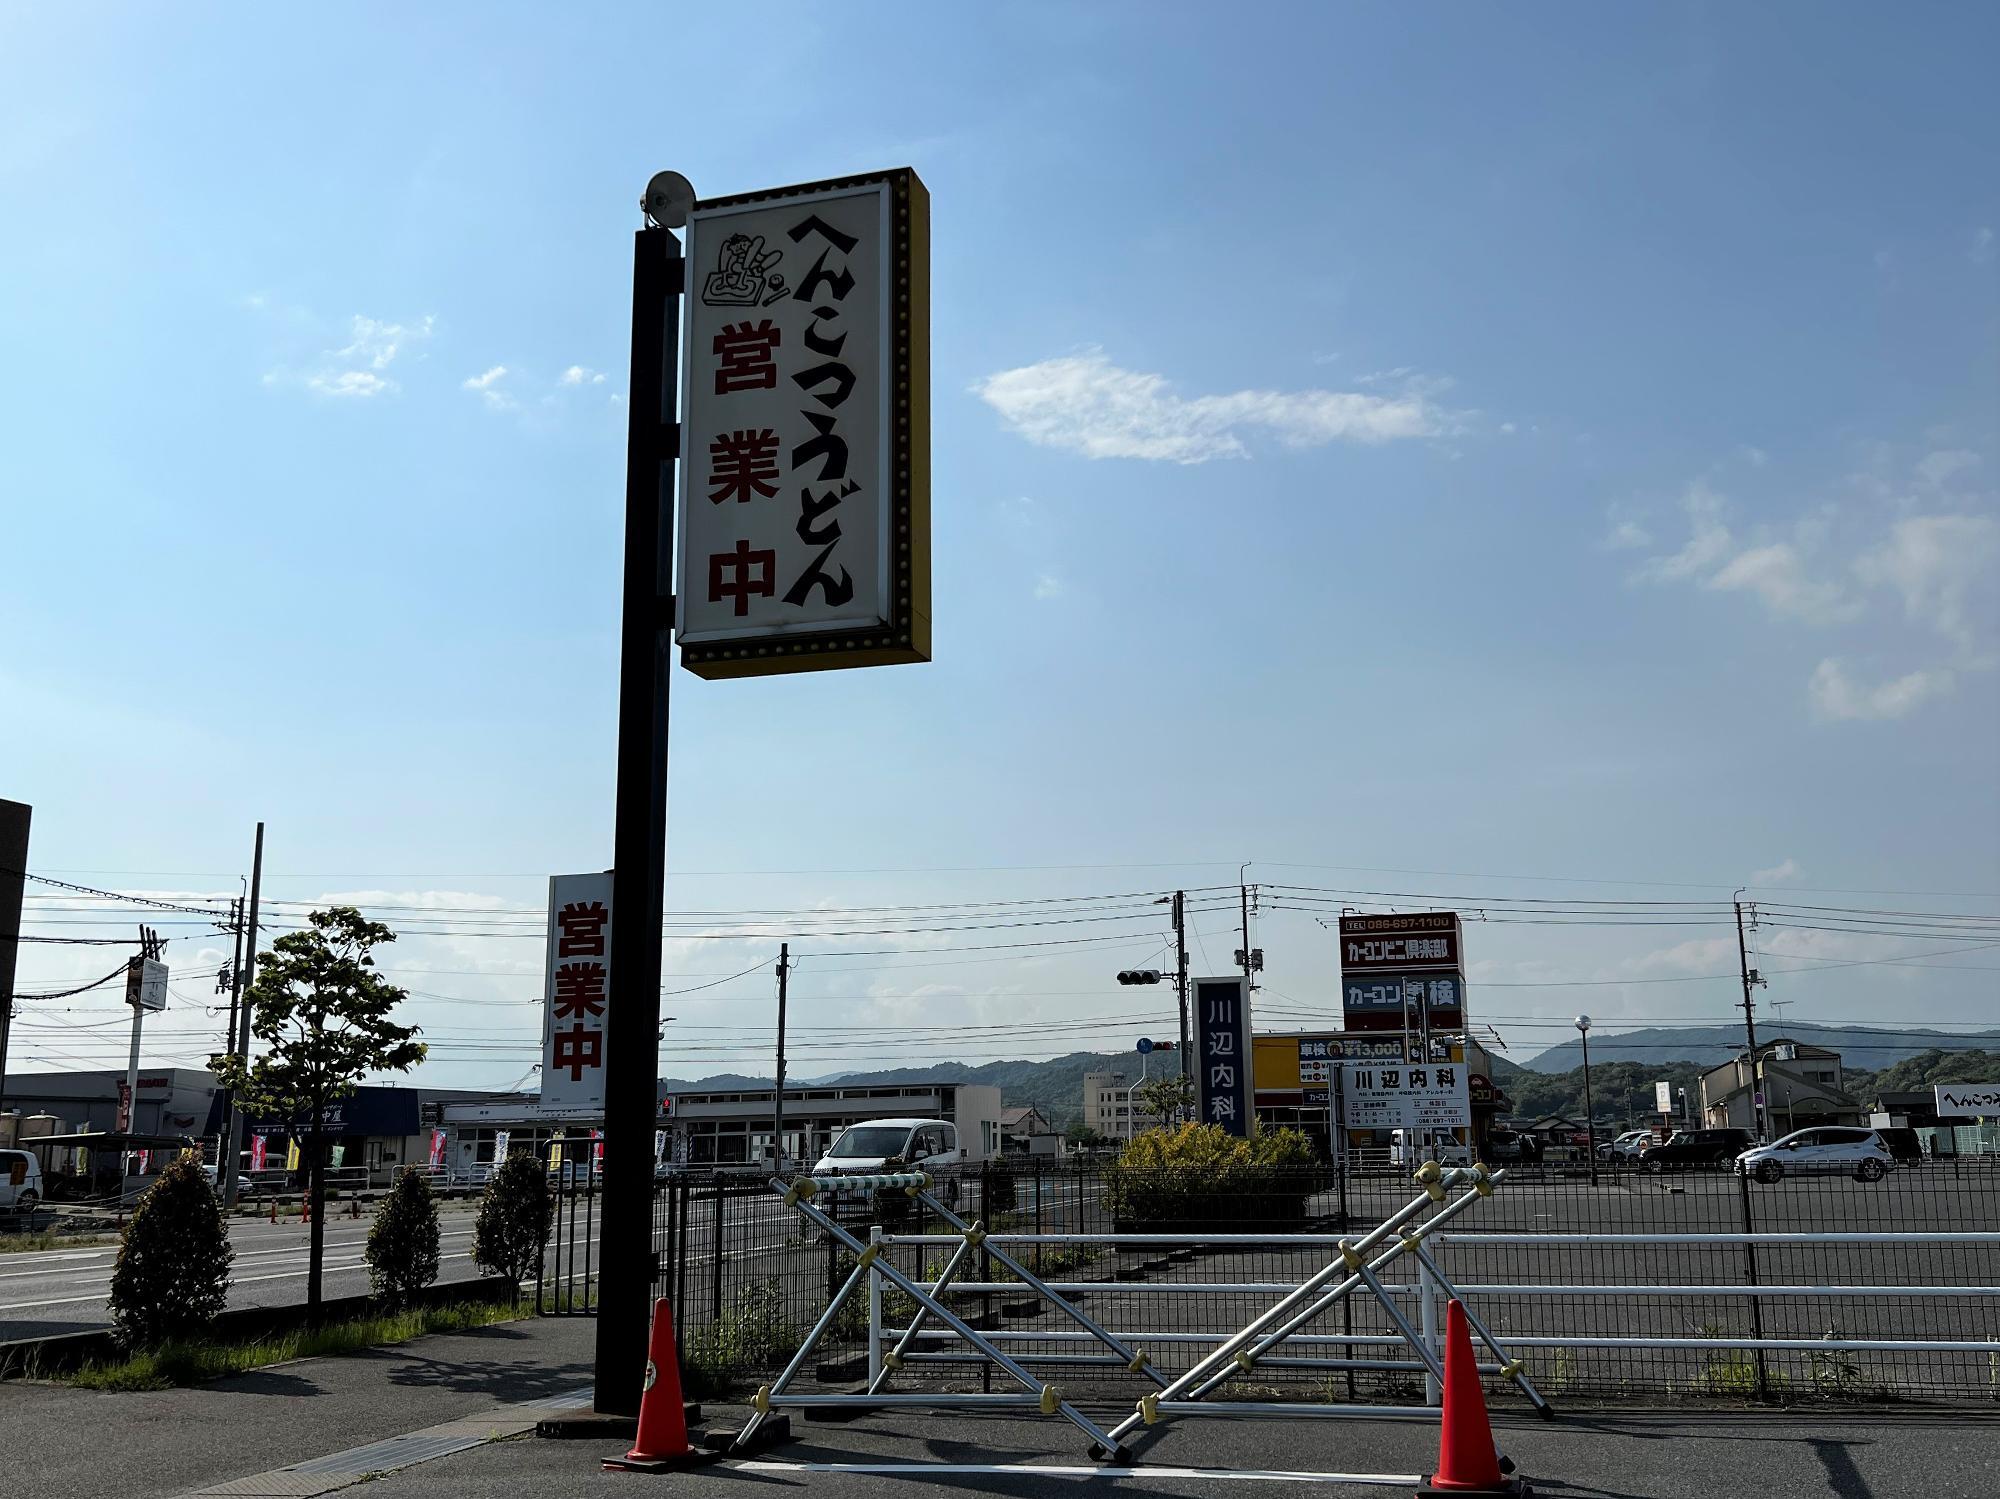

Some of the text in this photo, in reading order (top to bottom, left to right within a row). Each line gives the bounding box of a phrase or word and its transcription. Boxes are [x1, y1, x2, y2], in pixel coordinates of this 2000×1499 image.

[782, 214, 861, 608] へんこつうどん
[707, 318, 781, 617] 営業中
[1347, 917, 1449, 930] TEL 086-697-1100
[1347, 938, 1449, 962] カーコンビニ倶楽部
[552, 901, 608, 1082] 営業中
[1208, 1000, 1236, 1121] 川辺内科
[1300, 1043, 1327, 1057] 車検
[1355, 1068, 1456, 1089] 川辺内科
